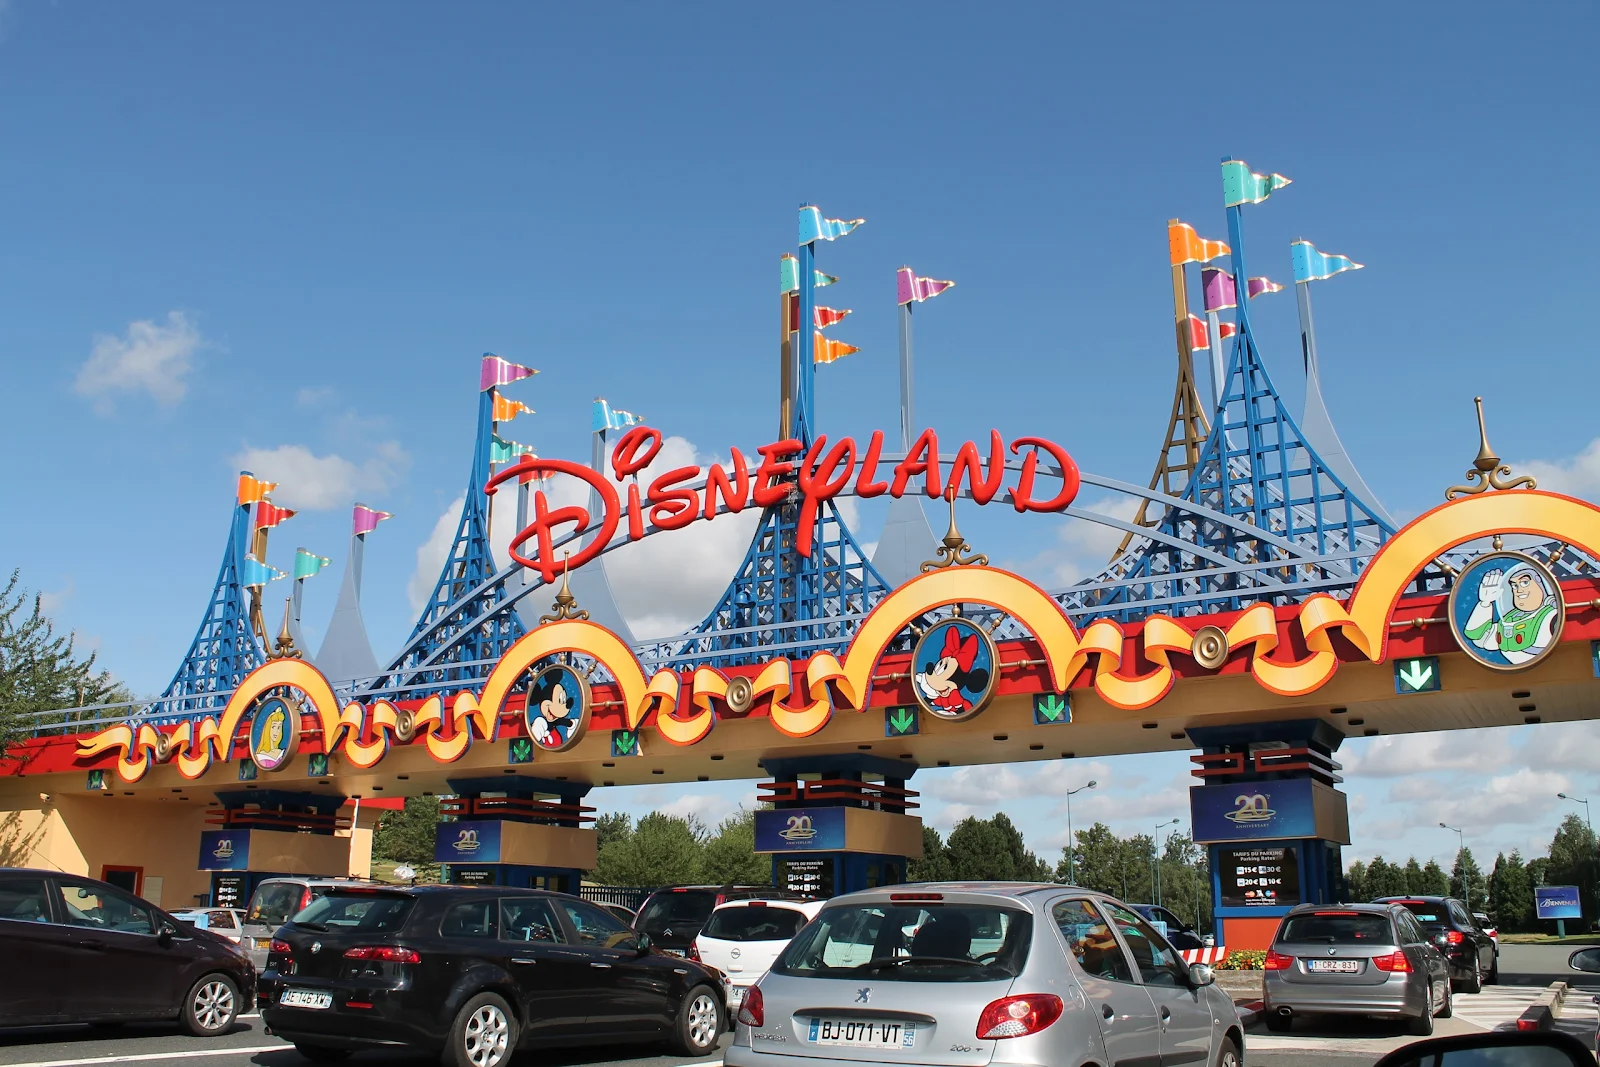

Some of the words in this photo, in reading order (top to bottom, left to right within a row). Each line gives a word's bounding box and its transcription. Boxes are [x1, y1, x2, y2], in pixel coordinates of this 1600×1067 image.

[484, 425, 1082, 583] DISNEYLAND
[786, 816, 812, 837] 20
[218, 840, 232, 856] 20
[459, 830, 477, 848] 20
[1540, 898, 1577, 907] BIENVENUE
[822, 1021, 901, 1043] BJ-071-VT
[903, 1034, 914, 1046] 56
